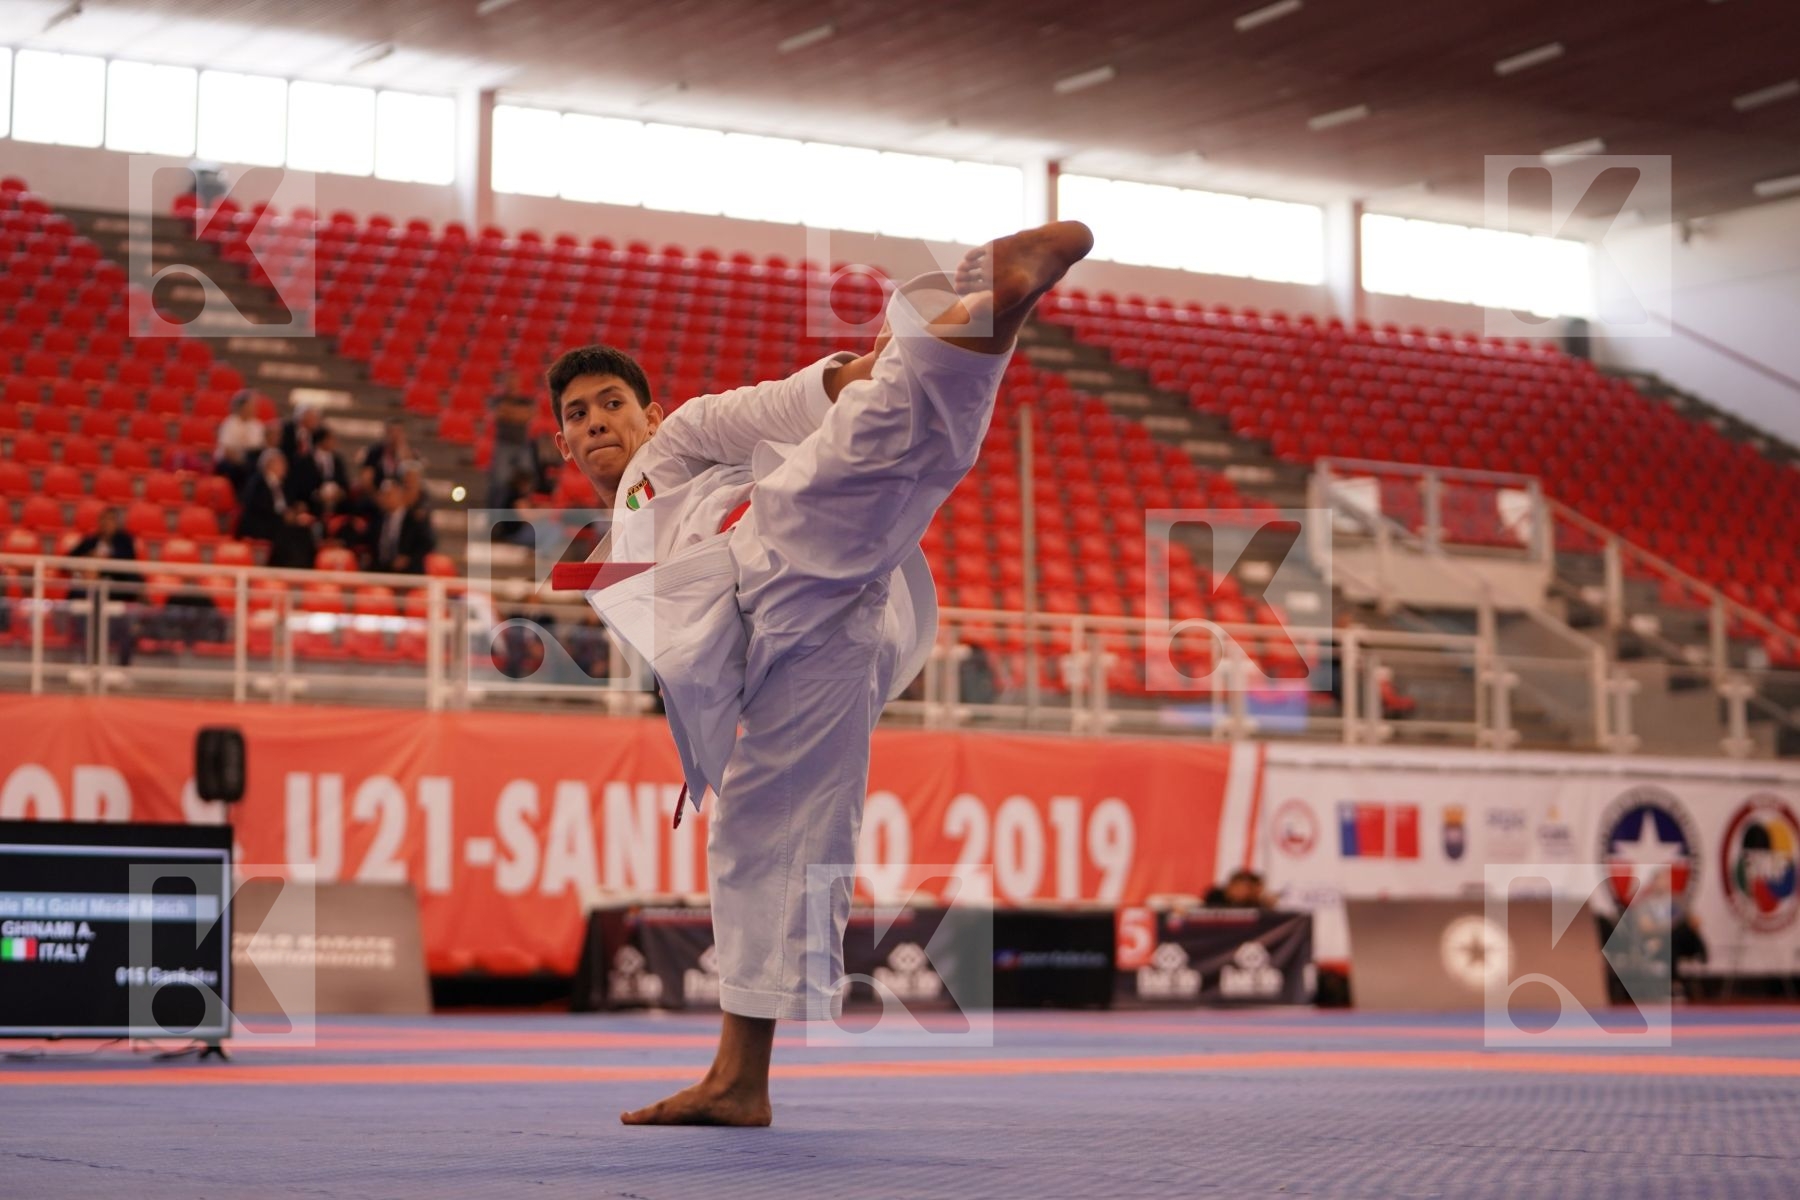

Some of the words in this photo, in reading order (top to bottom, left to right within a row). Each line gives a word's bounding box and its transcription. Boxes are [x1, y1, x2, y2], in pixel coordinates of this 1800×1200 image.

[943, 793, 1136, 905] 2019
[1, 920, 75, 939] GHINAMI
[76, 921, 96, 940] A.
[1117, 907, 1149, 967] 5
[38, 943, 89, 962] ITALY
